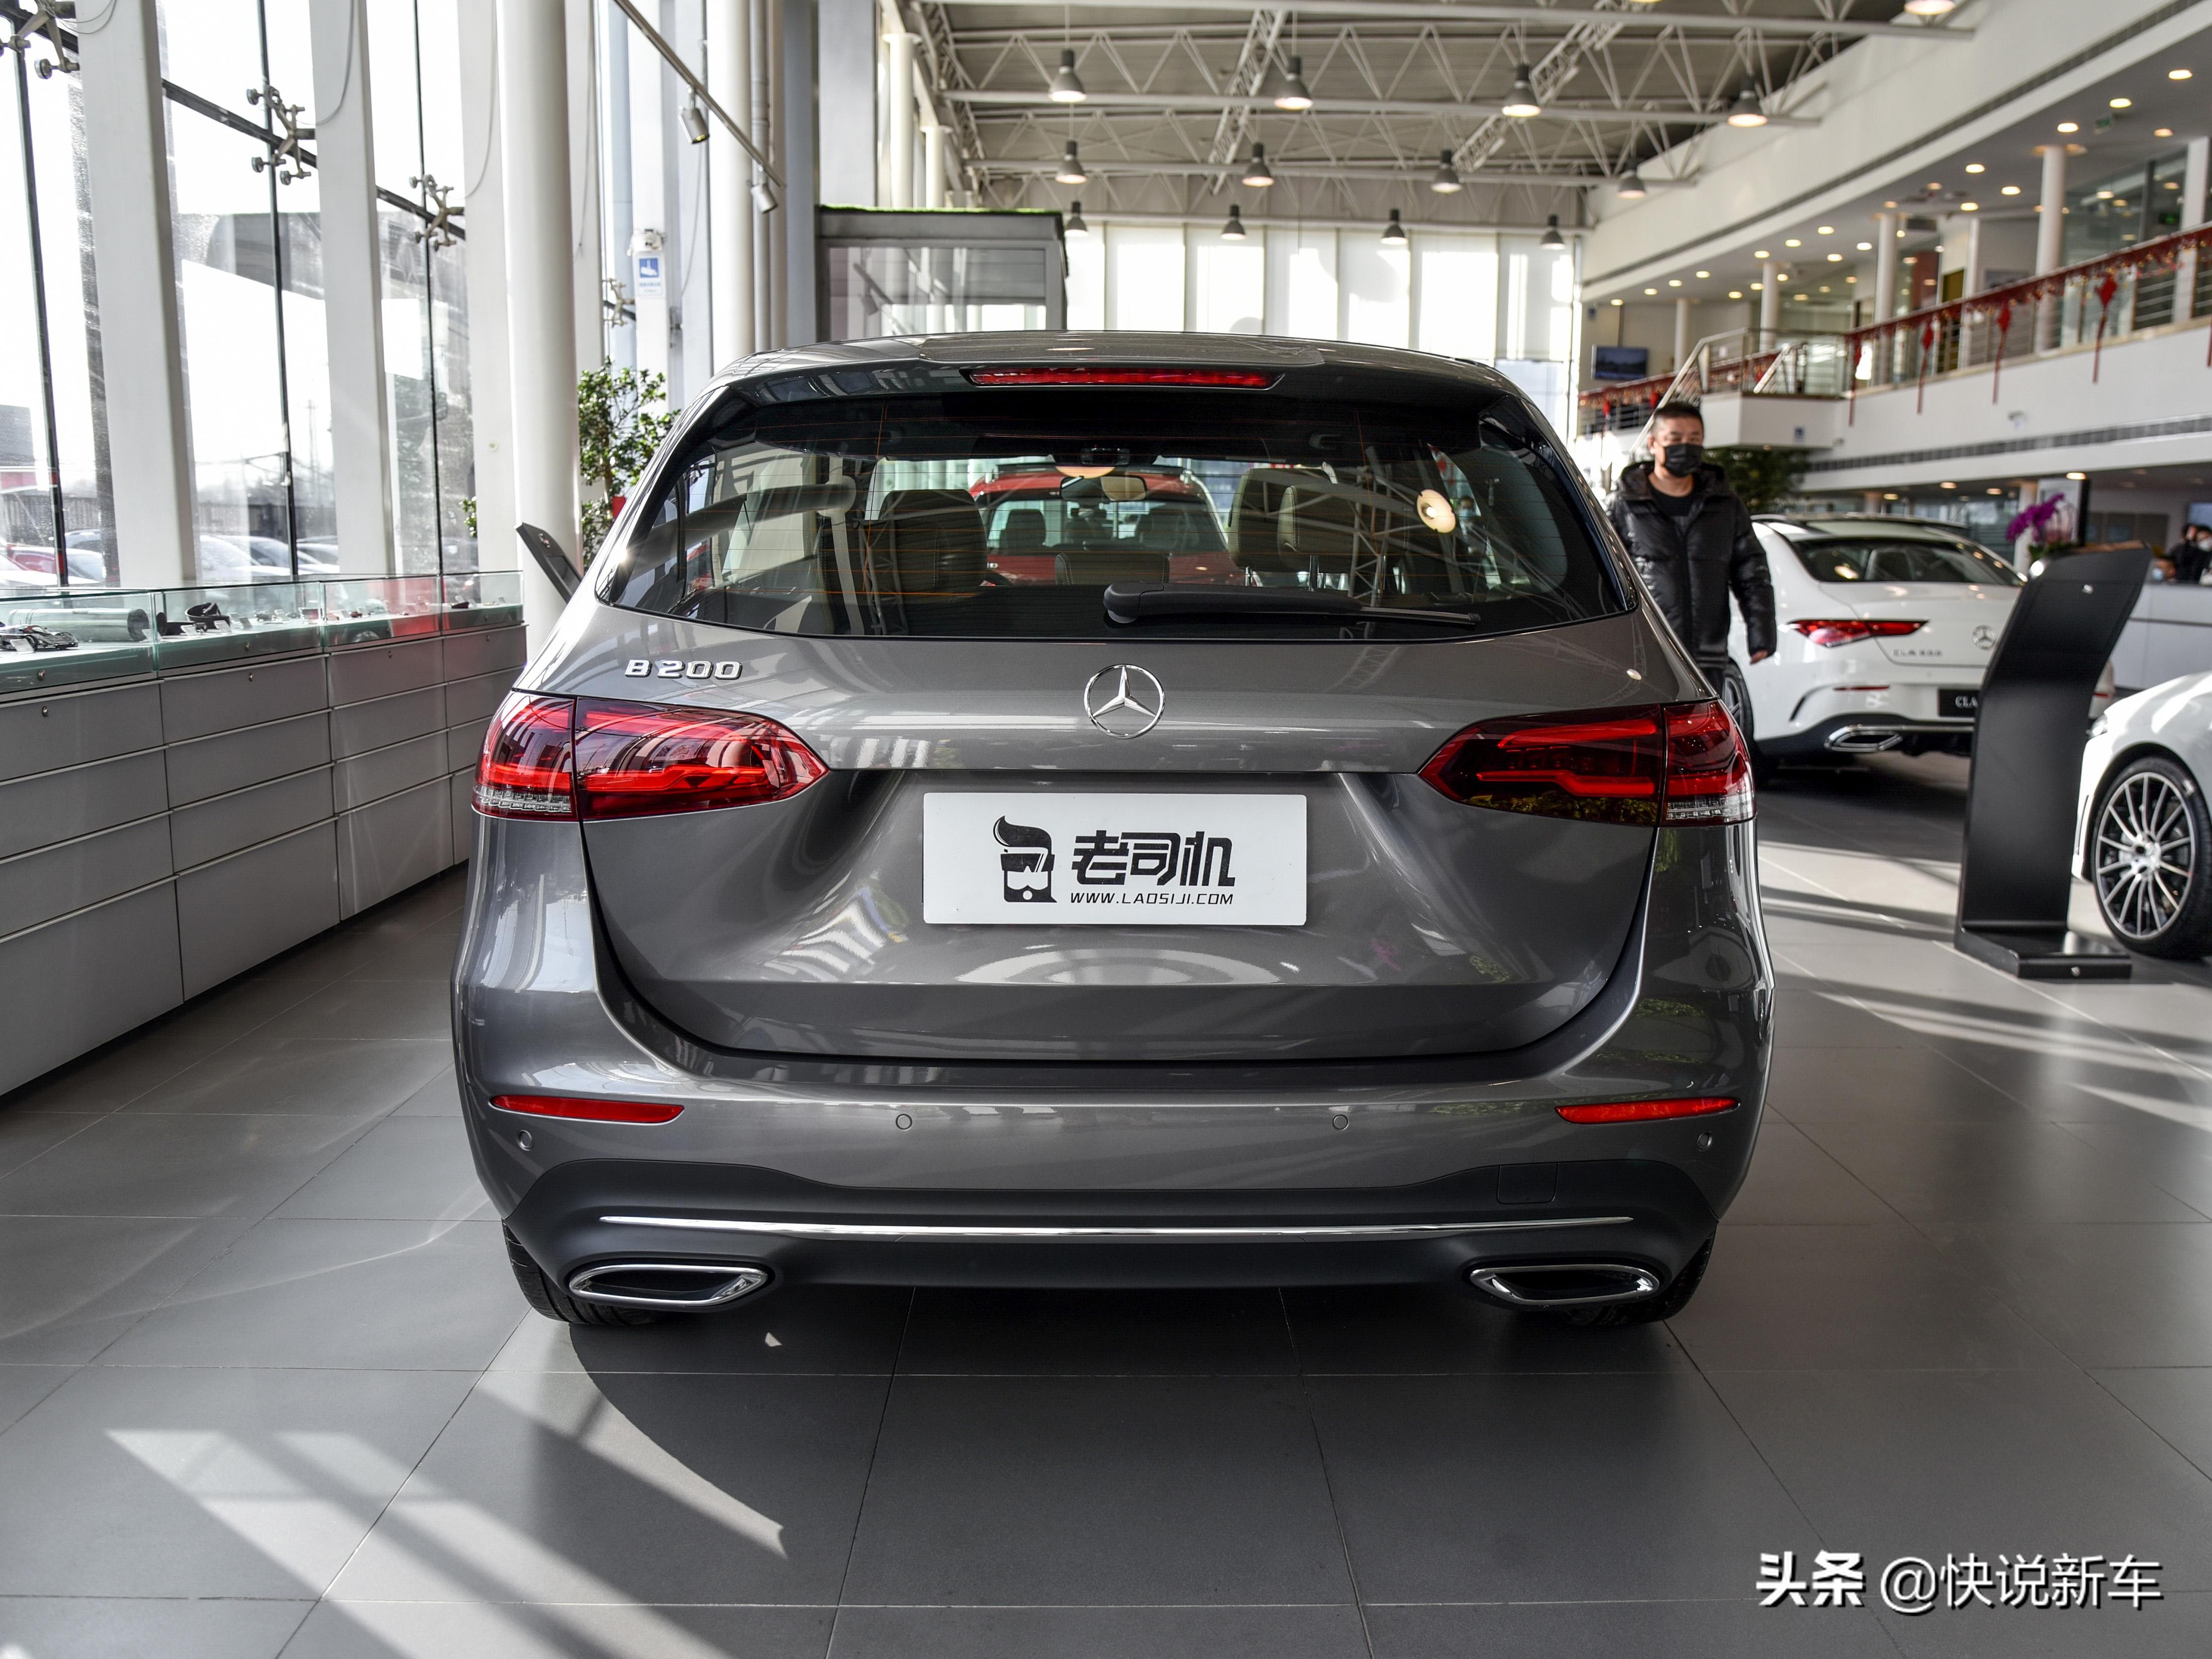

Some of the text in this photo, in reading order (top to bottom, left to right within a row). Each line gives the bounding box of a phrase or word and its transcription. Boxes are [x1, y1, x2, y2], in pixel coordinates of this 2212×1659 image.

[624, 660, 743, 679] B 200
[1955, 696, 1978, 708] CLA
[1071, 829, 1236, 887] 老司机
[1070, 892, 1234, 905] WWW.LAOSIJI.COM
